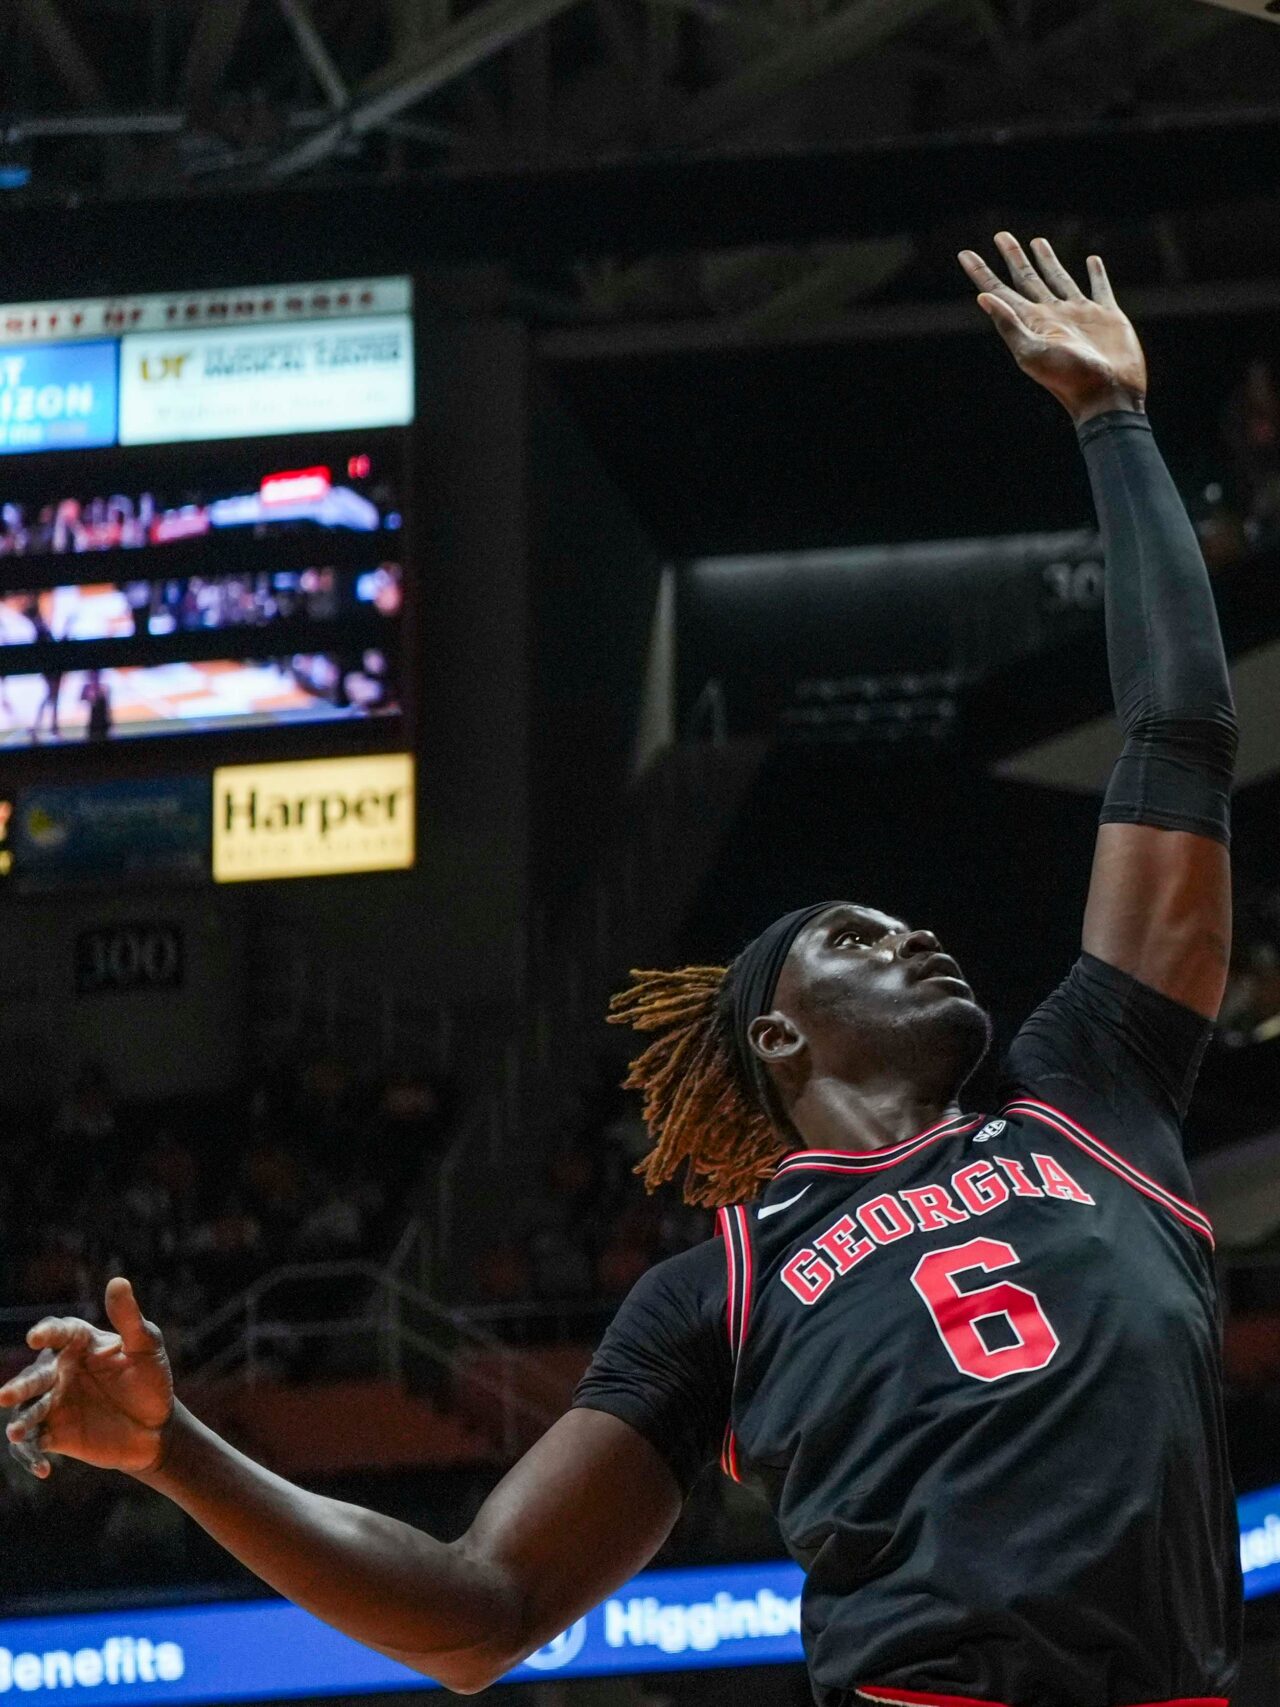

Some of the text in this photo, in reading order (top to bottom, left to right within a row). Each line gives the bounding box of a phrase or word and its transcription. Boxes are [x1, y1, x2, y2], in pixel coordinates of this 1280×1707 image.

[222, 787, 404, 838] Harper
[780, 1152, 1096, 1305] GEORGIA
[909, 1236, 1060, 1382] 6
